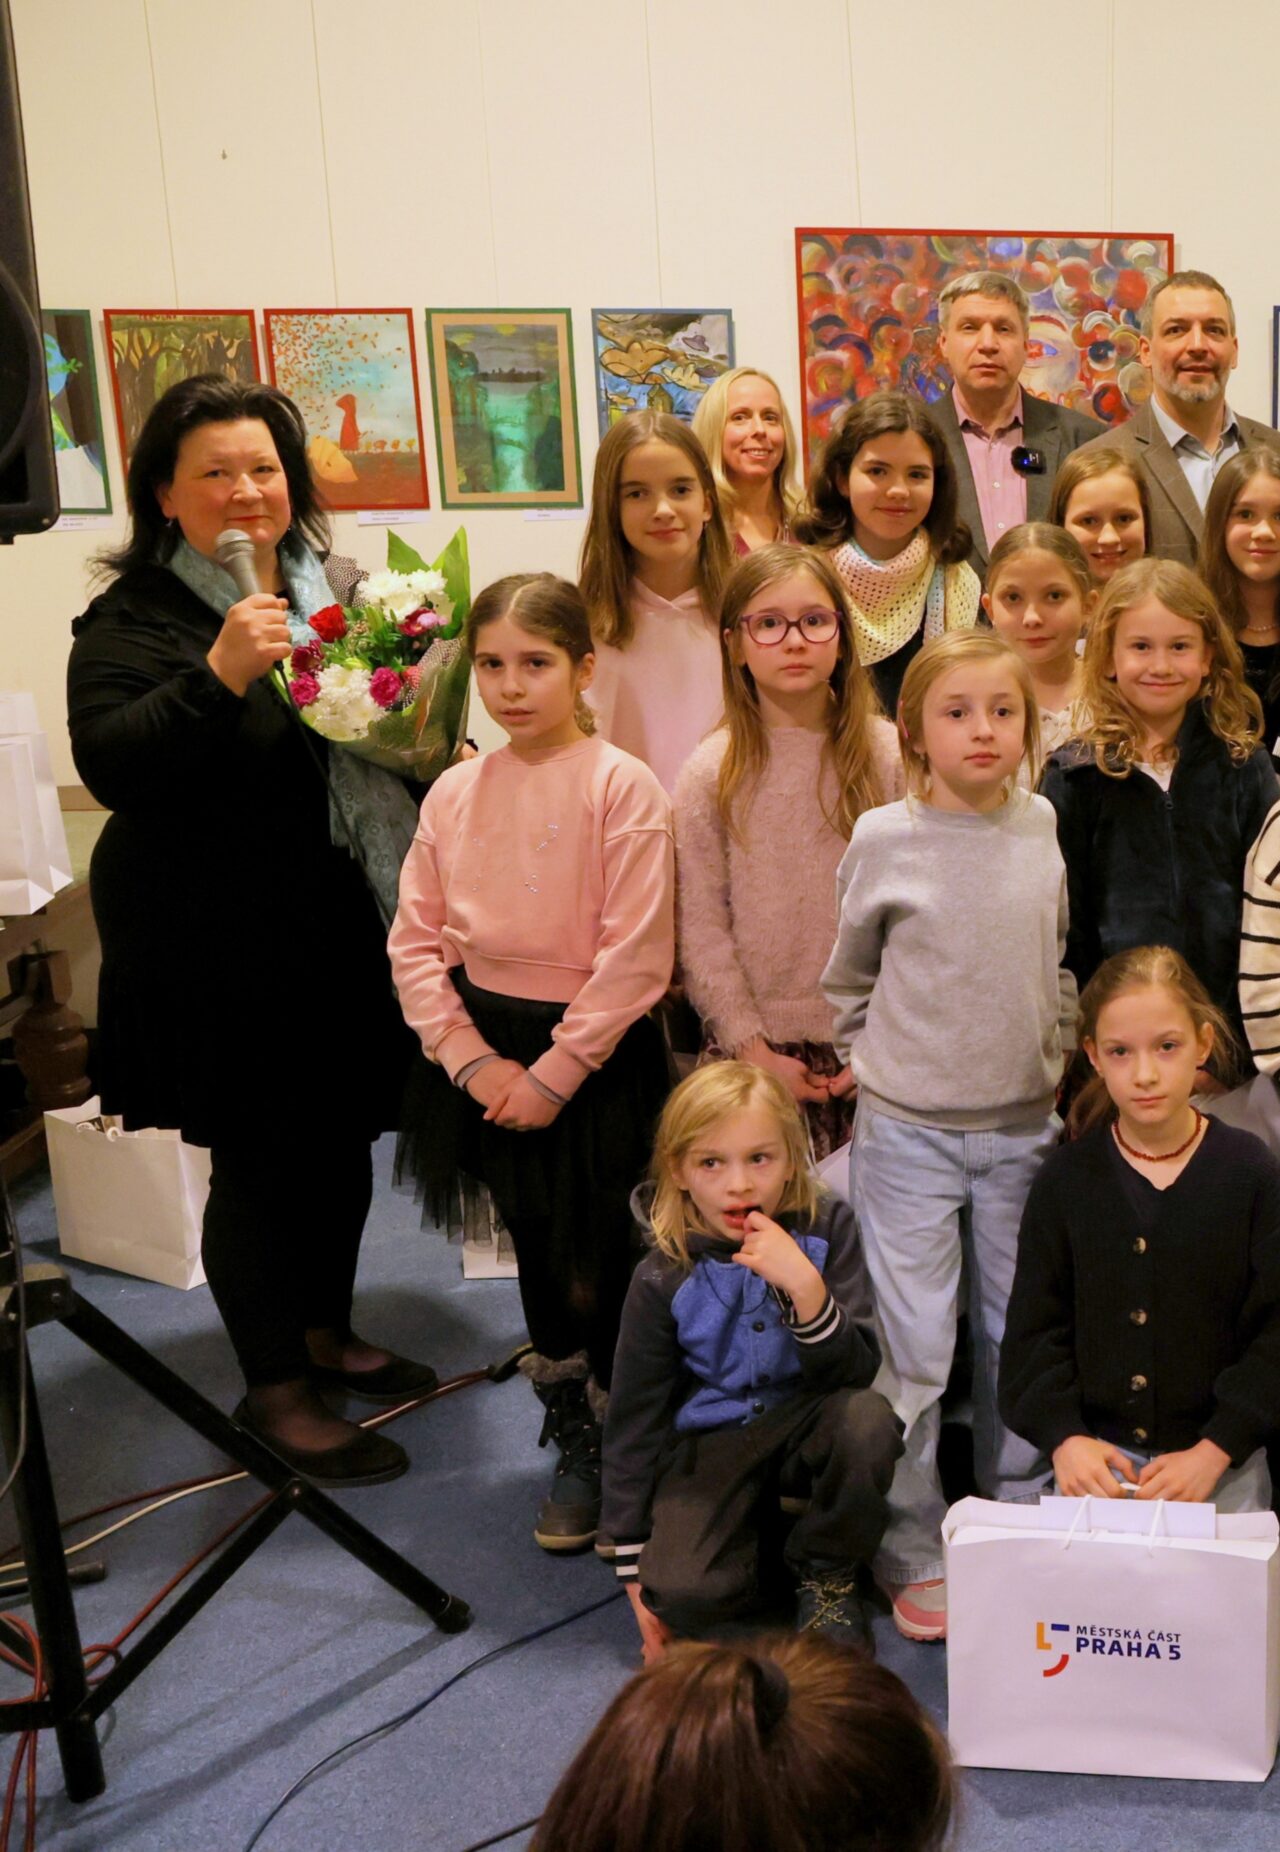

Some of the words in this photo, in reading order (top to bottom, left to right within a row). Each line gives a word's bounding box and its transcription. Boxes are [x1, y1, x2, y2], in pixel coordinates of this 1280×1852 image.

[1076, 1624, 1142, 1640] MĚSTSKÁ
[1147, 1630, 1182, 1643] ČÁST
[1076, 1637, 1162, 1660] PRAHA
[1168, 1645, 1182, 1661] 5
